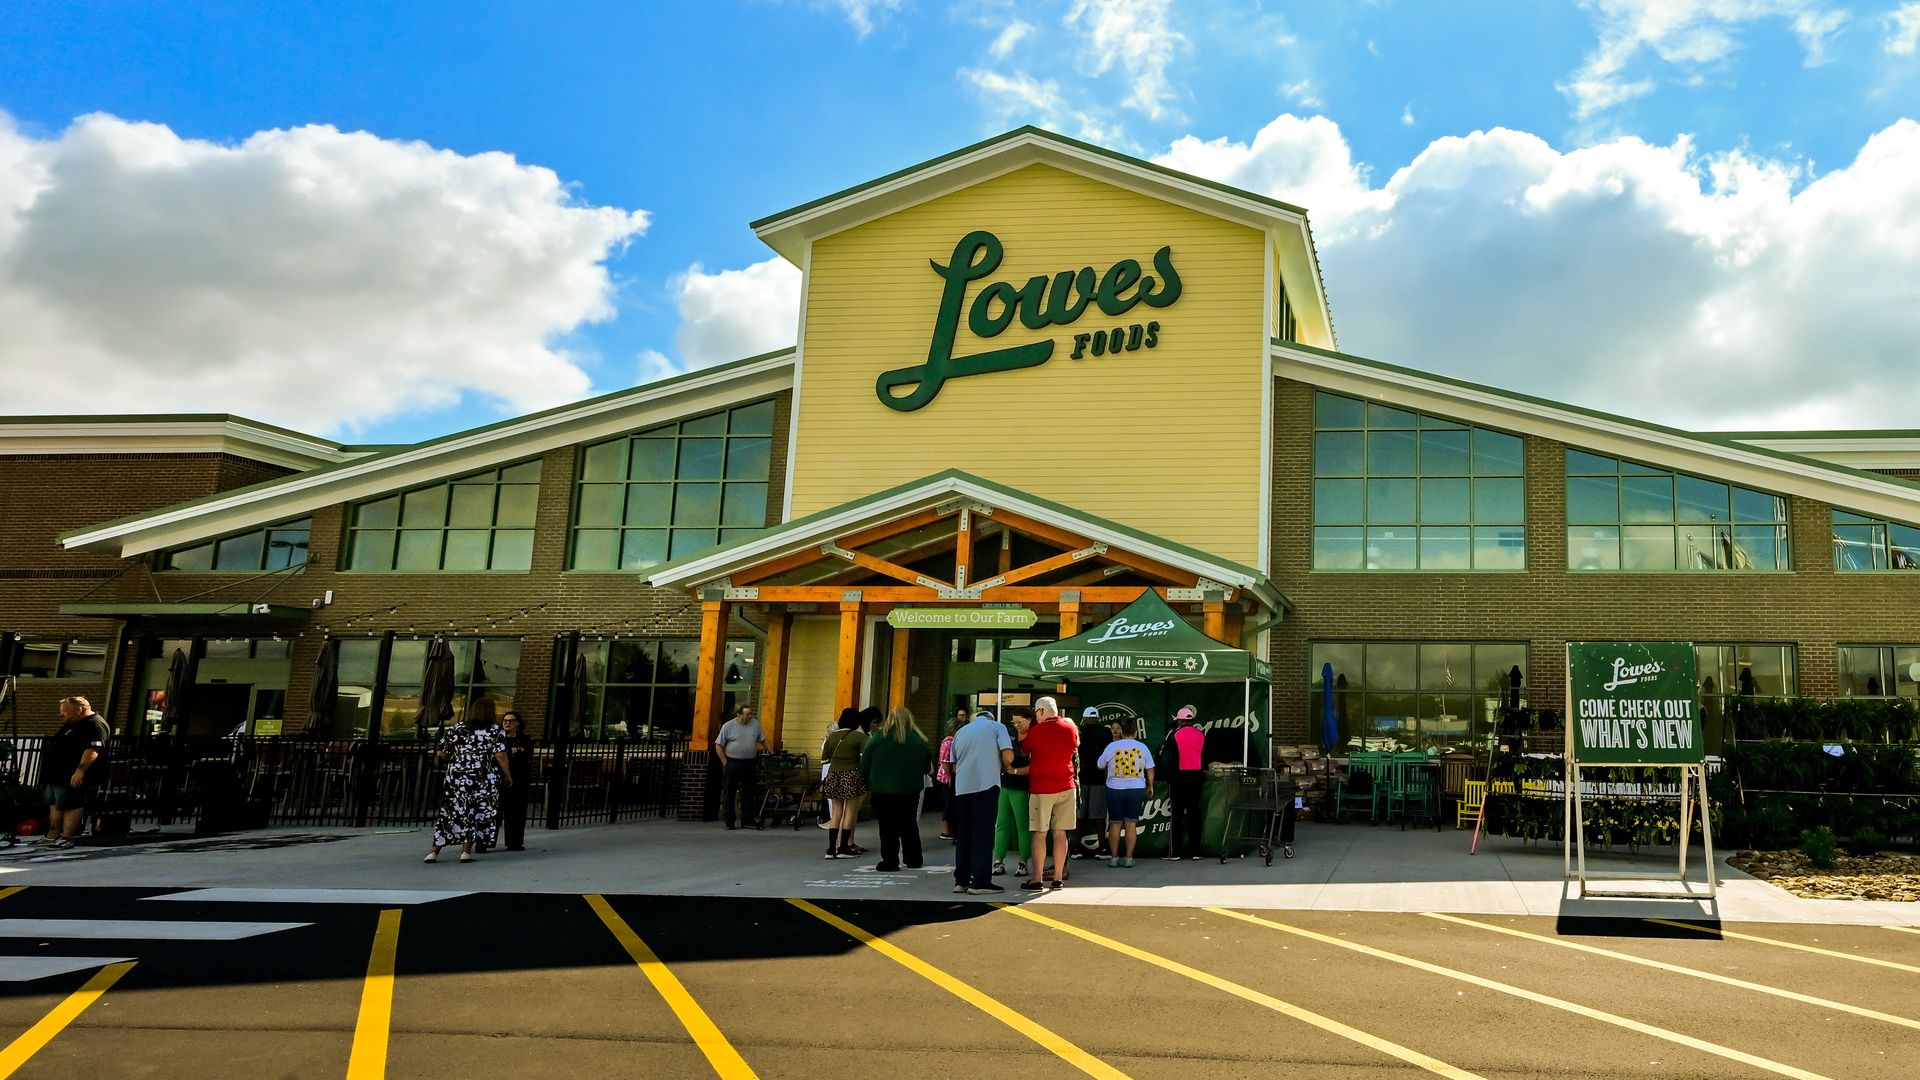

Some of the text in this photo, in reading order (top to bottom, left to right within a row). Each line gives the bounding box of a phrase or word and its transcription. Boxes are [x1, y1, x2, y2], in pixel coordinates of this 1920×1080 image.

[875, 230, 1182, 412] Lowes
[1070, 321, 1160, 360] FOODS
[895, 611, 1028, 623] Welcome to Our Farm
[1087, 617, 1175, 644] Lowes
[1074, 655, 1132, 669] HOMEGROWN
[1137, 659, 1178, 667] GROCER
[1603, 657, 1661, 692] Lowes
[1579, 699, 1692, 718] COME CHECK OUT
[1580, 719, 1693, 749] WHAT'S NEW
[1114, 748, 1143, 777] NC
[1151, 821, 1171, 833] FOO
